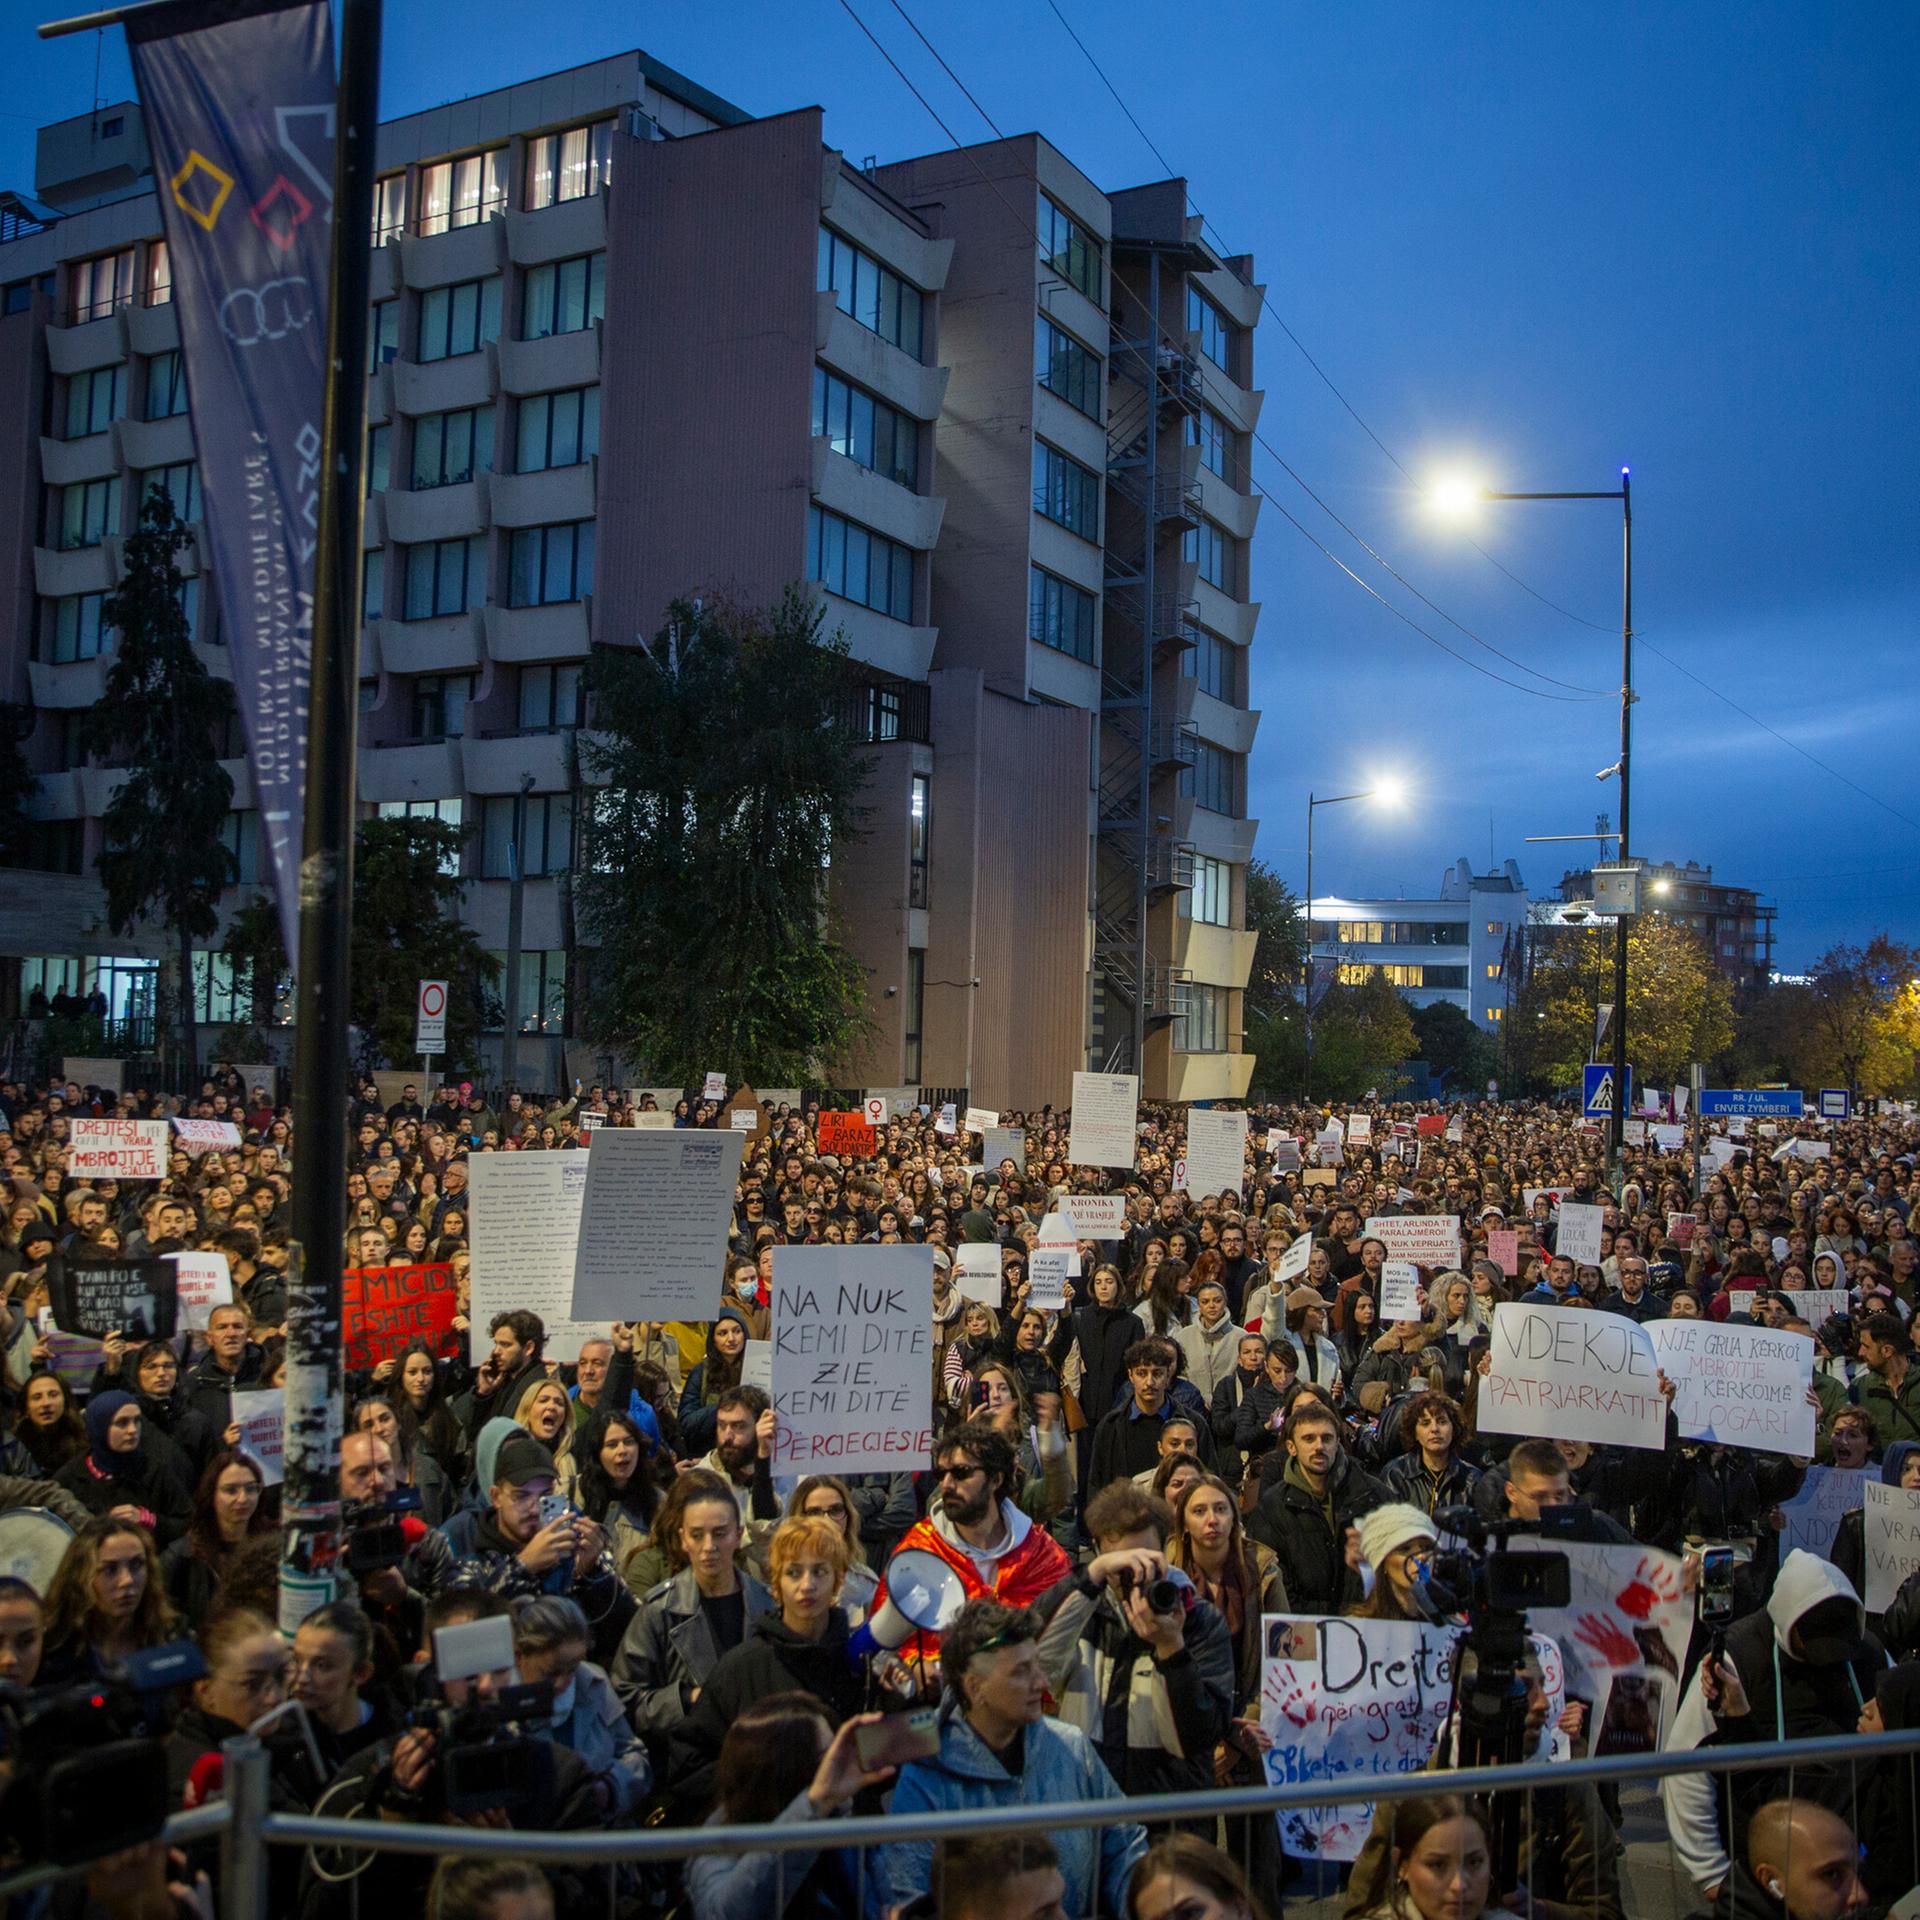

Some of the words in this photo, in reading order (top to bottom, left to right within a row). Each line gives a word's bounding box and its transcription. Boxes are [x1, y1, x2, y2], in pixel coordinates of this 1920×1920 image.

[821, 1114, 845, 1127] LIRI
[1714, 1103, 1745, 1113] ENVER
[1747, 1103, 1790, 1114] ZYMBERI
[75, 1149, 155, 1167] MBROJTJE
[1071, 1199, 1114, 1207] KRONIKA
[1403, 1219, 1439, 1227] ARLINDA
[1391, 1240, 1409, 1248] NUK
[1410, 1240, 1454, 1248] VEPRUAT?
[343, 1268, 457, 1305] EMICIDI
[778, 1284, 820, 1317] NA
[837, 1283, 907, 1316] NUK
[776, 1324, 847, 1355] KEMI
[862, 1323, 926, 1354] DITË
[1499, 1314, 1649, 1377] VDEKJE
[1657, 1327, 1697, 1352] NJË
[1704, 1334, 1742, 1358] GRUA
[811, 1361, 878, 1386] ZIE.
[1671, 1376, 1691, 1393] OT
[773, 1391, 836, 1416] KEMI
[846, 1384, 911, 1413] DITË
[1488, 1375, 1663, 1422] PATRIARKATIT
[1676, 1396, 1789, 1434] LLOGARI
[1867, 1484, 1891, 1506] NJE
[1317, 1619, 1450, 1717] Drejtë
